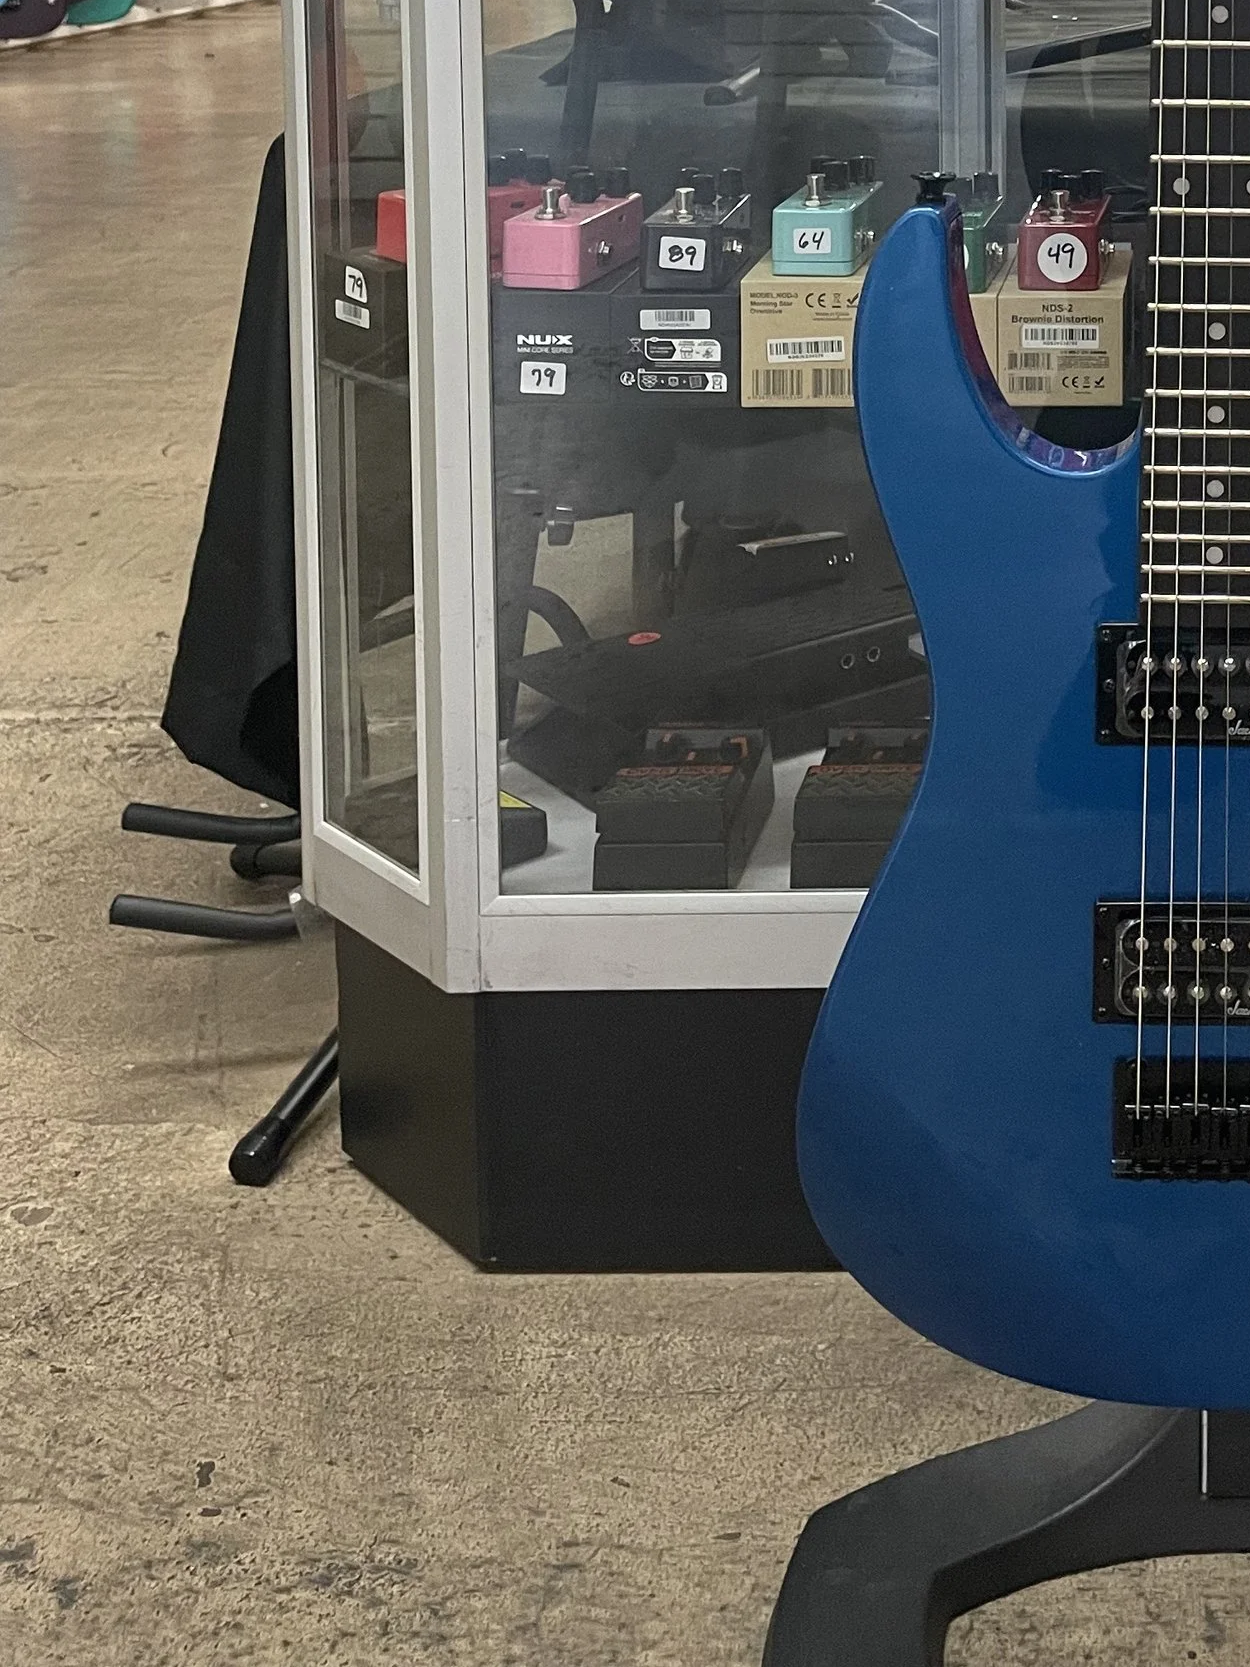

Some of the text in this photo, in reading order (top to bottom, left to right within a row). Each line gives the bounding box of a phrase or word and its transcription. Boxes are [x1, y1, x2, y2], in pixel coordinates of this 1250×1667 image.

[798, 231, 825, 251] 64
[668, 244, 697, 266] 89
[1047, 242, 1075, 269] 49
[348, 274, 363, 299] 79
[1041, 303, 1074, 313] NDS-2
[1011, 314, 1105, 324] Brownie Distortion
[516, 334, 573, 346] NUX
[531, 367, 557, 388] 79
